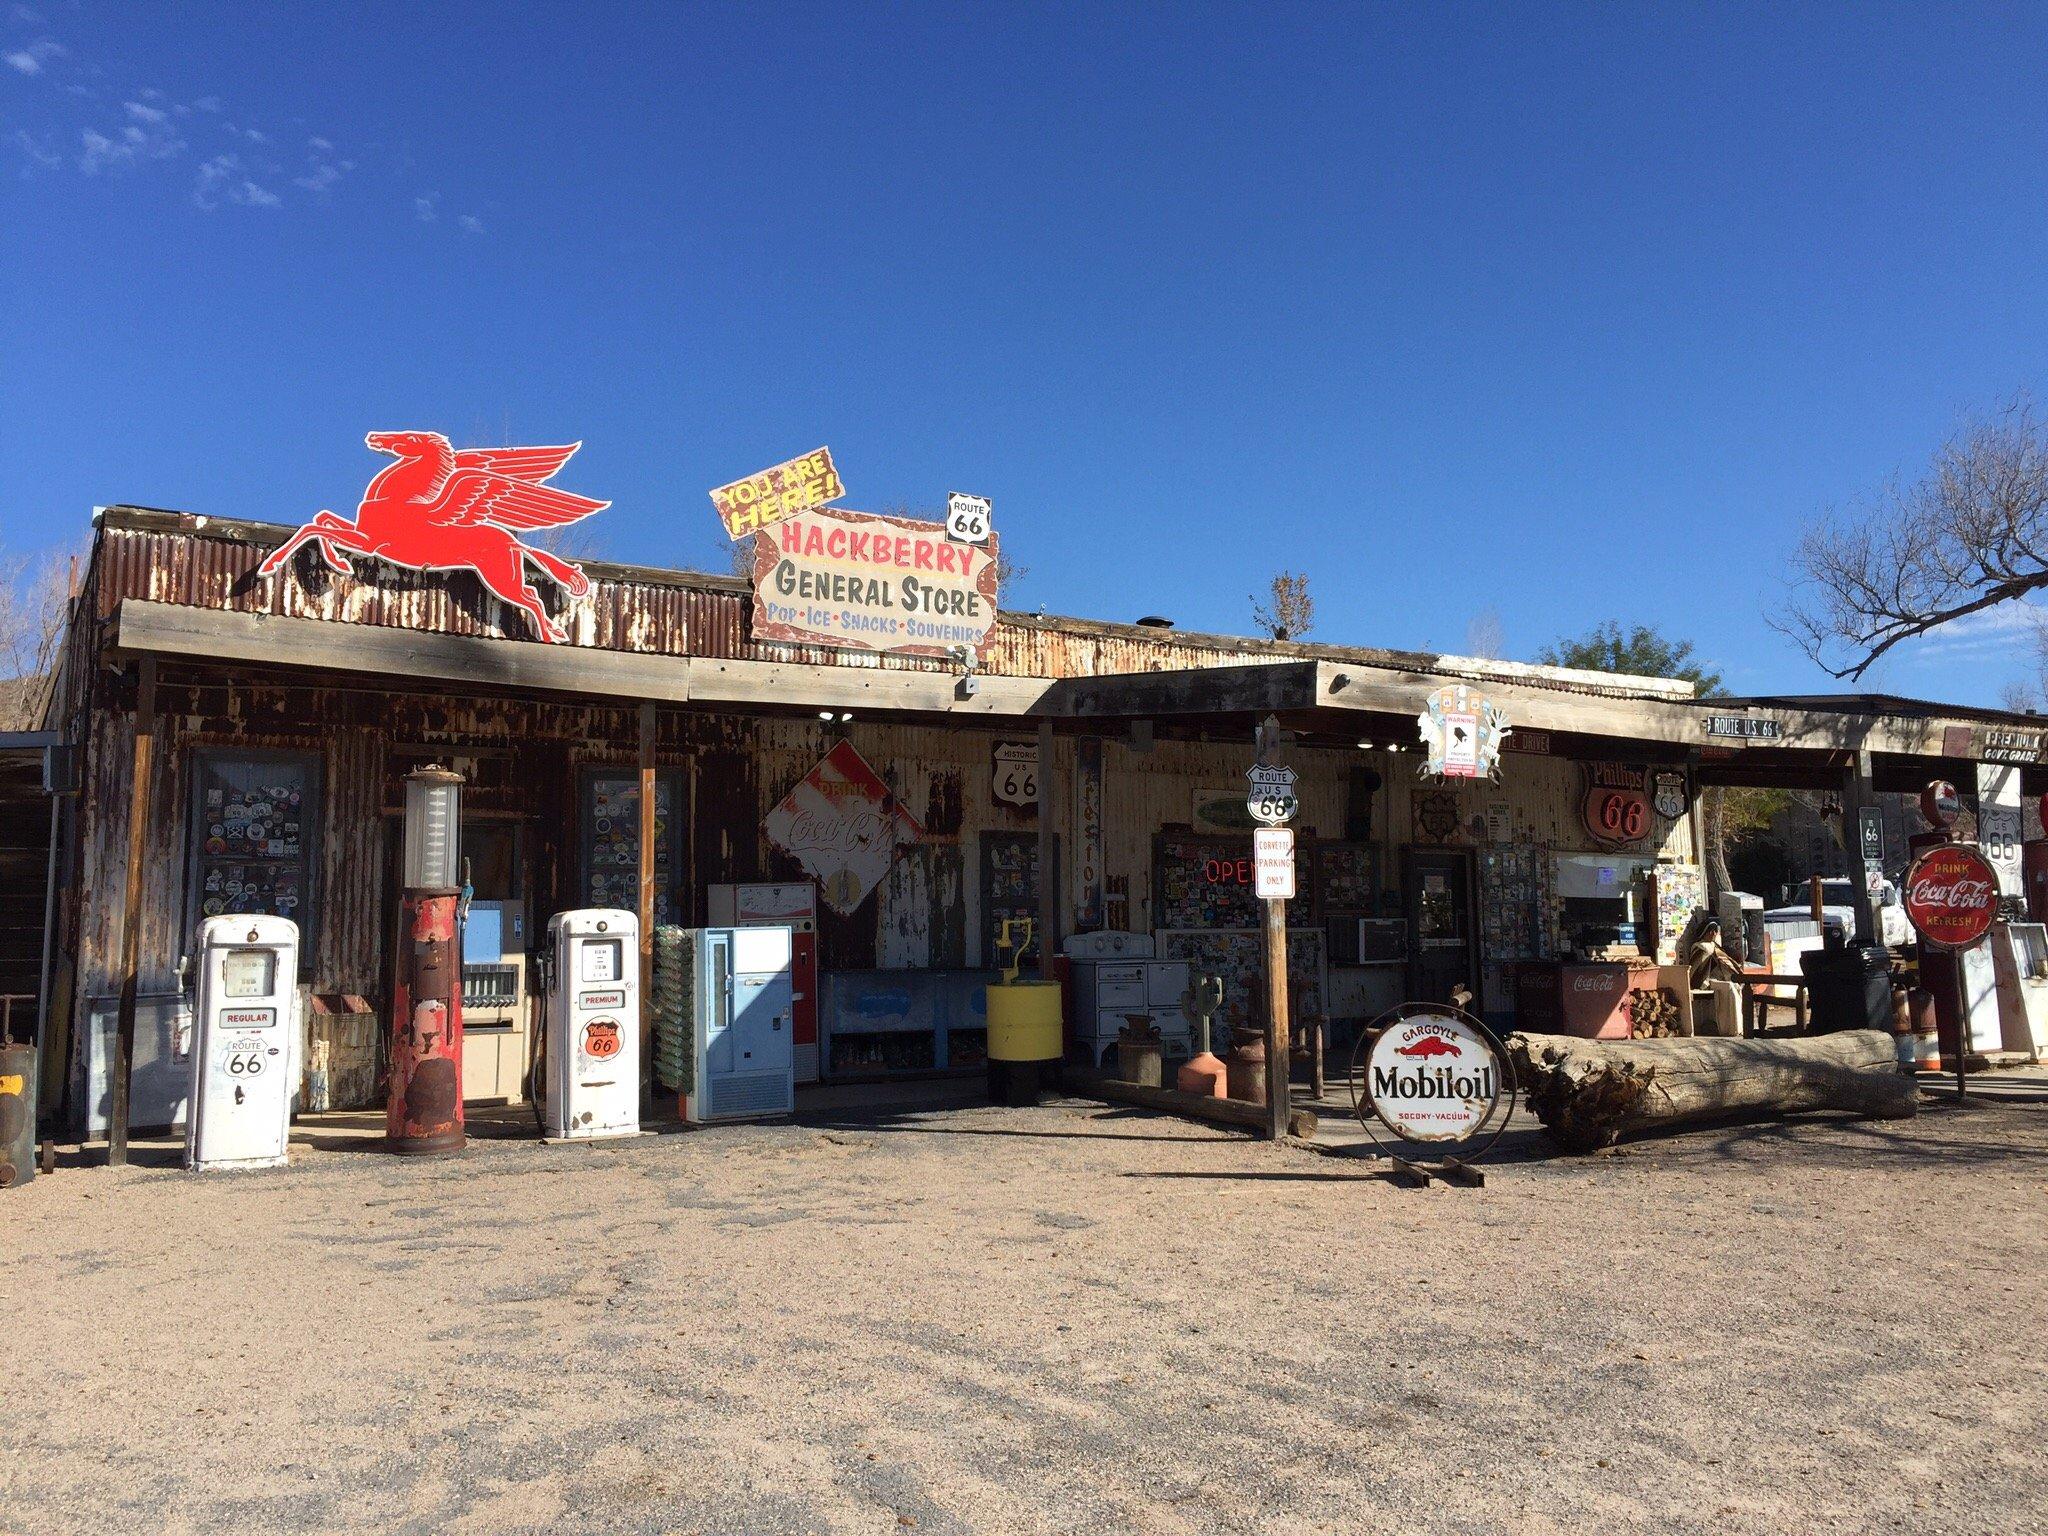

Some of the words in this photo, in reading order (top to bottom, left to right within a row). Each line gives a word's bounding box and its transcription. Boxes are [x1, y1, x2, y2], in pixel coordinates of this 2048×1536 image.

[721, 475, 773, 509] YOU
[782, 454, 828, 487] ARE
[730, 473, 836, 535] HERE!
[953, 501, 985, 515] ROUTE
[954, 514, 983, 535] 66
[781, 521, 976, 577] HACKBERRY
[775, 559, 894, 608] GENERAL
[900, 575, 980, 617] STORE
[1448, 716, 1475, 724] WARNING
[1714, 717, 1739, 735] ROUTE
[1744, 720, 1759, 736] U.S.
[1762, 721, 1773, 736] 66
[1004, 750, 1036, 759] HISTORIC
[2009, 750, 2037, 762] GRADE
[1258, 773, 1287, 782] ROUTE
[1595, 762, 1642, 788] Phillips
[1659, 774, 1679, 784] ROUTE
[821, 782, 869, 796] DRINK
[1004, 773, 1037, 796] 66
[1260, 796, 1286, 816] 66
[1660, 796, 1678, 812] 66
[1602, 795, 1645, 836] 66
[1994, 822, 2007, 831] US
[1866, 828, 1878, 841] 66
[1258, 842, 1289, 851] CORVETTE
[1989, 832, 2014, 859] 66
[1258, 859, 1291, 868] PARKING
[1934, 863, 1970, 873] DRINK
[1266, 876, 1284, 885] ONLY
[1911, 879, 1991, 908] Coca-Cola
[585, 995, 618, 1004] PREMIUM
[227, 1014, 268, 1023] REGULAR
[589, 1026, 616, 1038] Phillips
[232, 1042, 261, 1050] ROUTE
[592, 1038, 613, 1053] 66
[230, 1053, 262, 1074] 66
[1373, 1065, 1494, 1099] Mobiloil
[1398, 1112, 1471, 1121] SOCONY-VACUUM
